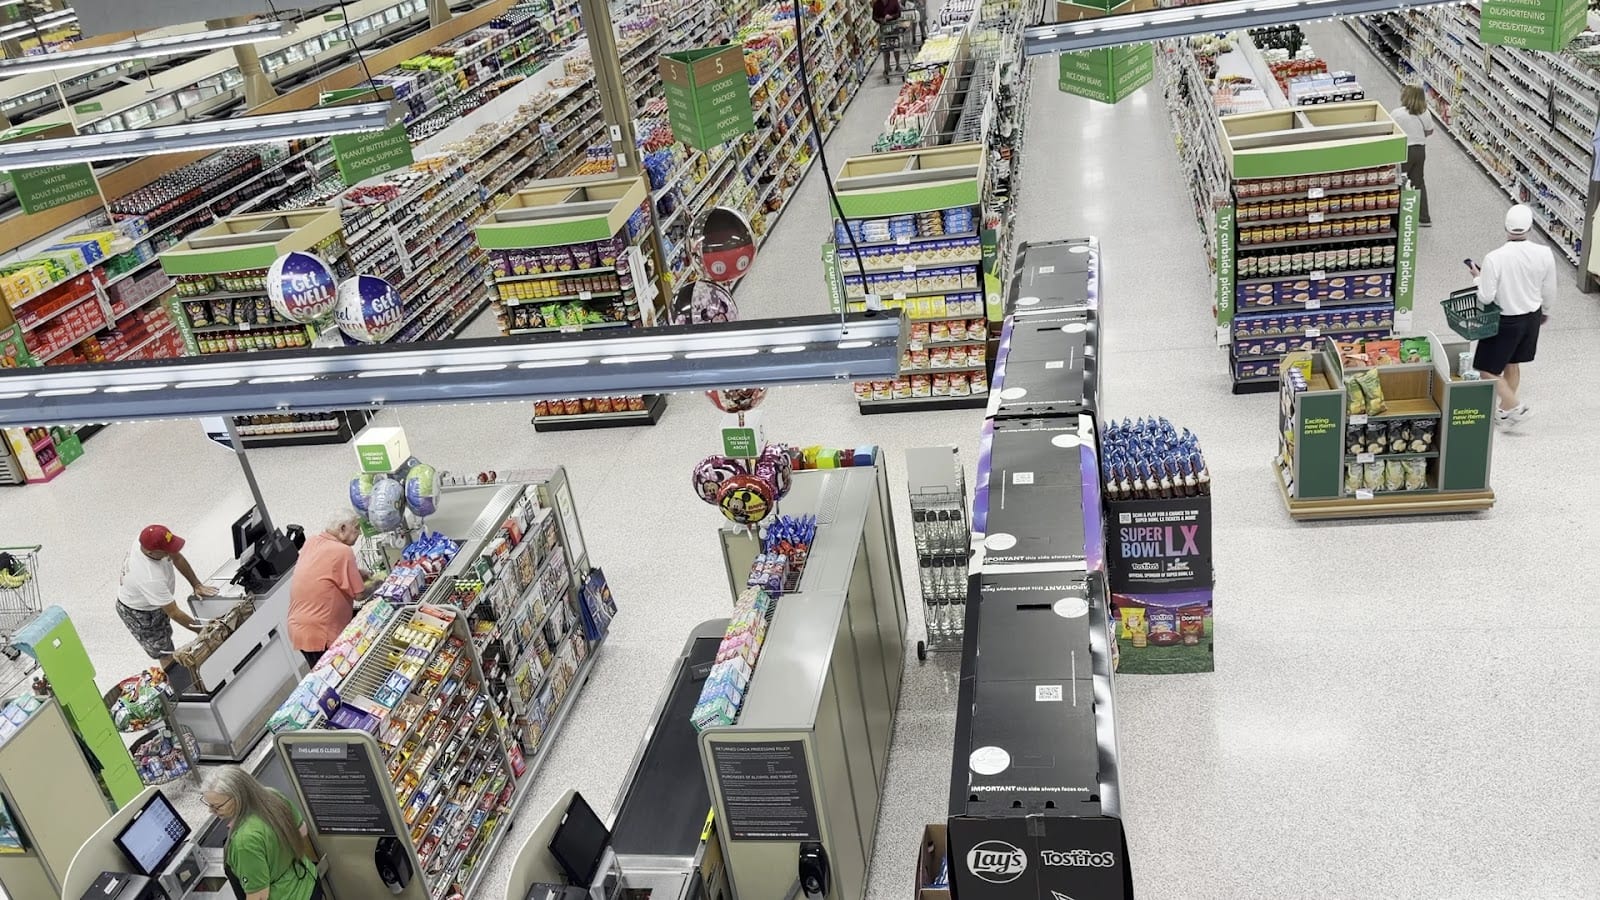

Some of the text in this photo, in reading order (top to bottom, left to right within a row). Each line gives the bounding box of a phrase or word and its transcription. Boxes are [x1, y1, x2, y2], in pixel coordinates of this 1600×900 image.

[1489, 7, 1545, 21] OIL/SHORTENING
[1488, 20, 1545, 35] SPICES/EXTRACTS
[1503, 35, 1526, 46] SUGAR
[670, 64, 677, 80] 5
[715, 57, 723, 74] 5
[712, 78, 733, 92] COOKIES
[712, 91, 736, 105] CRACKERS
[719, 105, 732, 116] NUTS
[717, 115, 740, 129] POPCORN
[357, 131, 384, 143] CANDIES
[720, 127, 740, 140] SNACKS
[341, 135, 405, 161] PEANUT BUTTER/JELLY
[350, 147, 403, 170] SCHOOL SUPPLIES
[22, 166, 55, 180] SPECIALTY
[371, 163, 391, 175] JUICES
[43, 174, 66, 185] WATER
[31, 178, 88, 201] ADULT NUTRIENTS
[33, 188, 94, 212] DIET SUPPLEMENTS
[1400, 195, 1416, 296] Try curbside pickup.
[825, 249, 834, 264] Try
[1219, 214, 1231, 312] Try curbside pickup.
[829, 266, 840, 305] curbside
[292, 285, 331, 306] WELL
[373, 306, 402, 327] WELL
[172, 301, 181, 314] Try
[177, 316, 194, 350] curbside
[394, 440, 401, 459] 7
[1120, 526, 1163, 542] SUPER
[1164, 524, 1200, 557] LX
[1121, 541, 1164, 558] BOWL
[698, 713, 720, 728] mentos
[973, 850, 1023, 873] Lay's
